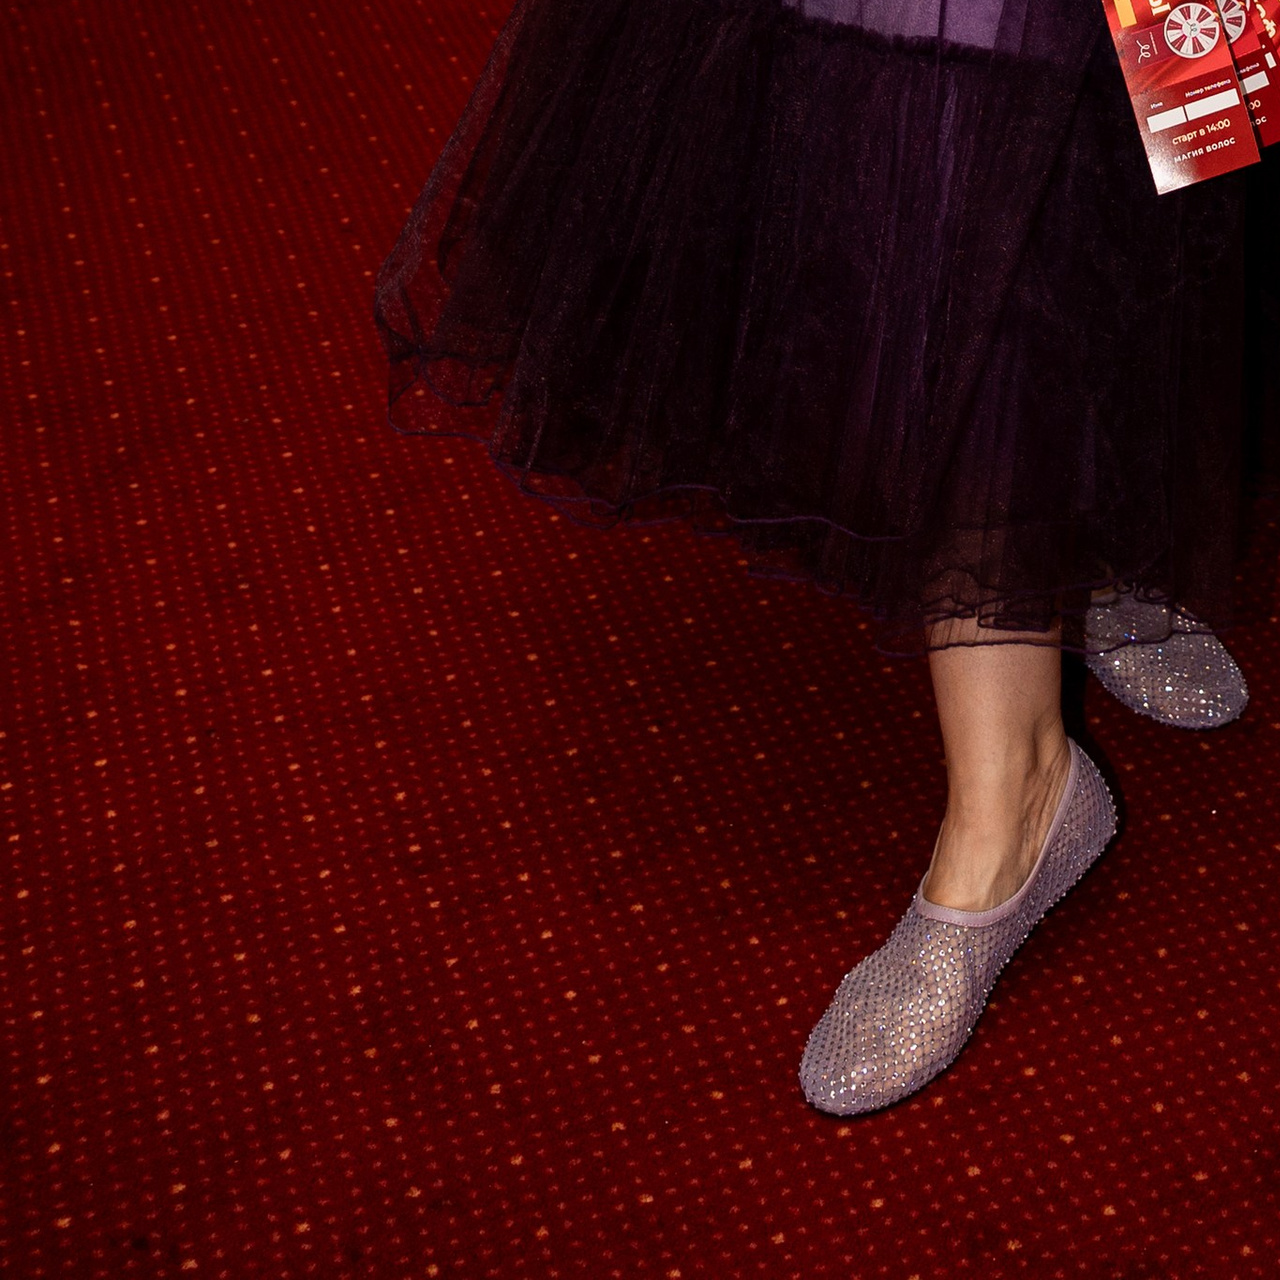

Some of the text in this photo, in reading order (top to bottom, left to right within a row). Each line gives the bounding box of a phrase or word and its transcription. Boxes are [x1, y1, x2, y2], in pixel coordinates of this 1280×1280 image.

[1172, 130, 1198, 146] старт
[1206, 118, 1231, 134] 14:00
[1174, 149, 1204, 163] МАГИЯ
